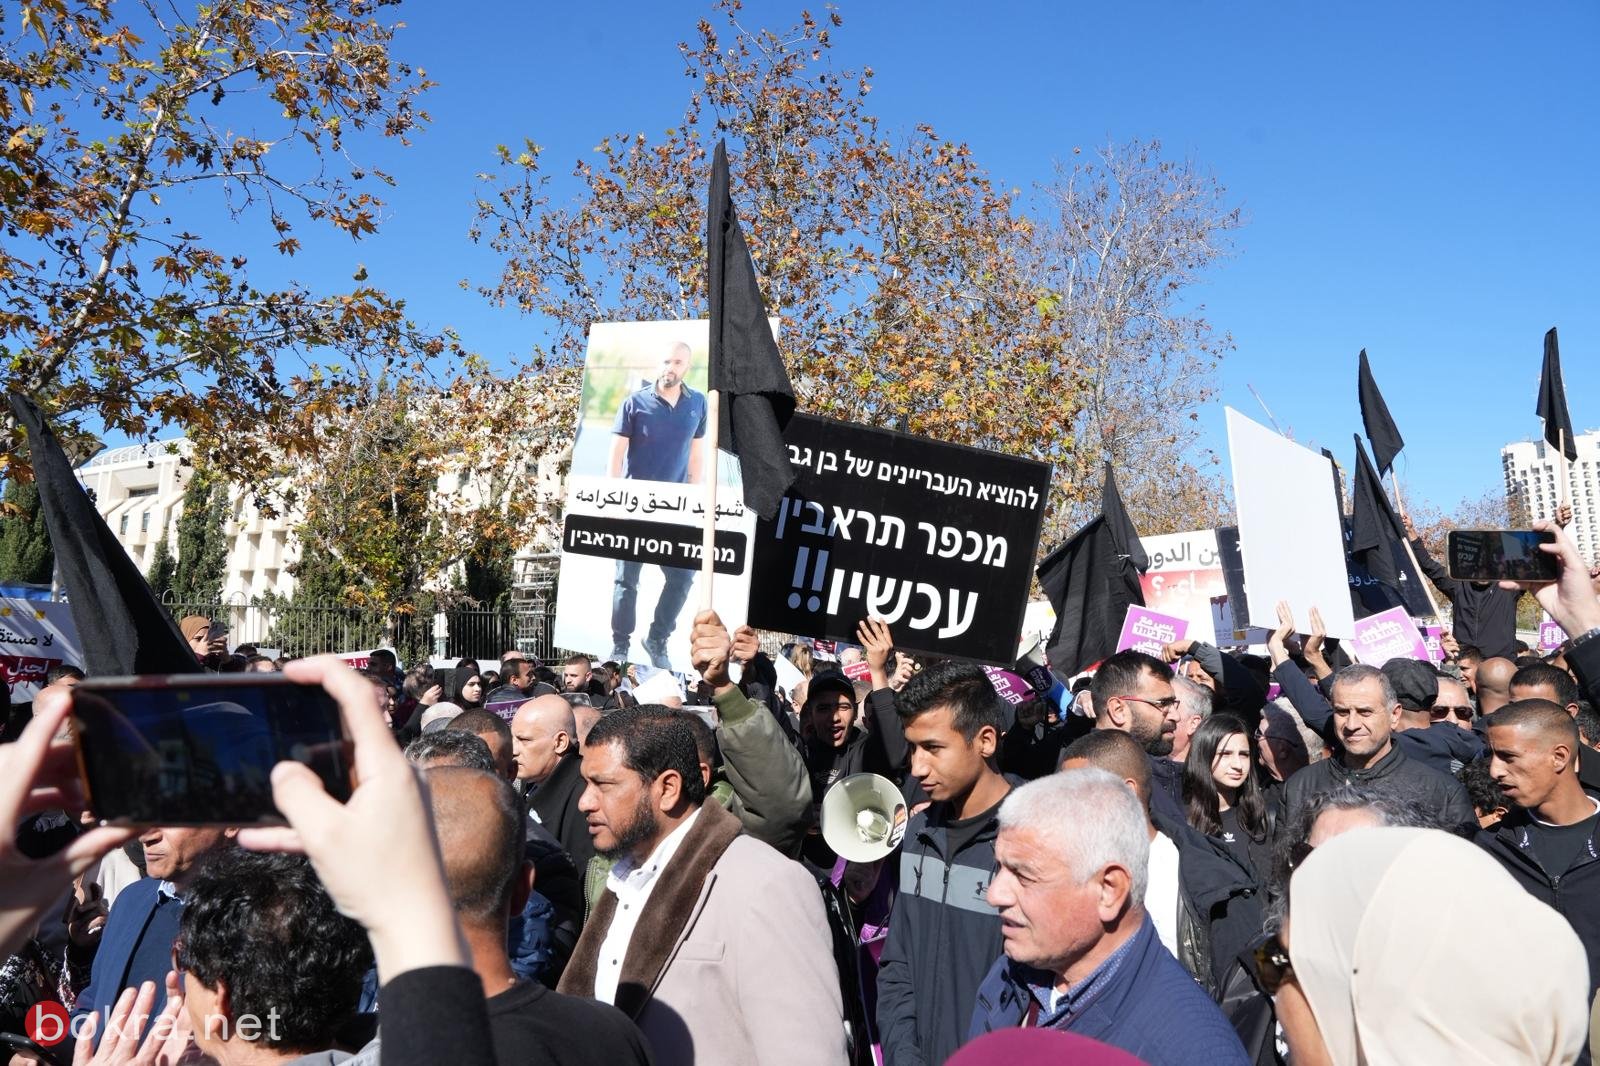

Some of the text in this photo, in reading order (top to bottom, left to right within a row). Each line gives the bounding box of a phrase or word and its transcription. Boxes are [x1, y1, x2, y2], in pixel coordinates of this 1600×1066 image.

[783, 444, 1039, 510] להוציא העבריינים של בן גב
[642, 493, 687, 514] الحق
[692, 499, 744, 522] شهد
[569, 529, 629, 550] תראבין
[775, 497, 1009, 568] מכפר תראבין
[634, 538, 673, 556] חסין
[43, 633, 54, 647] لا
